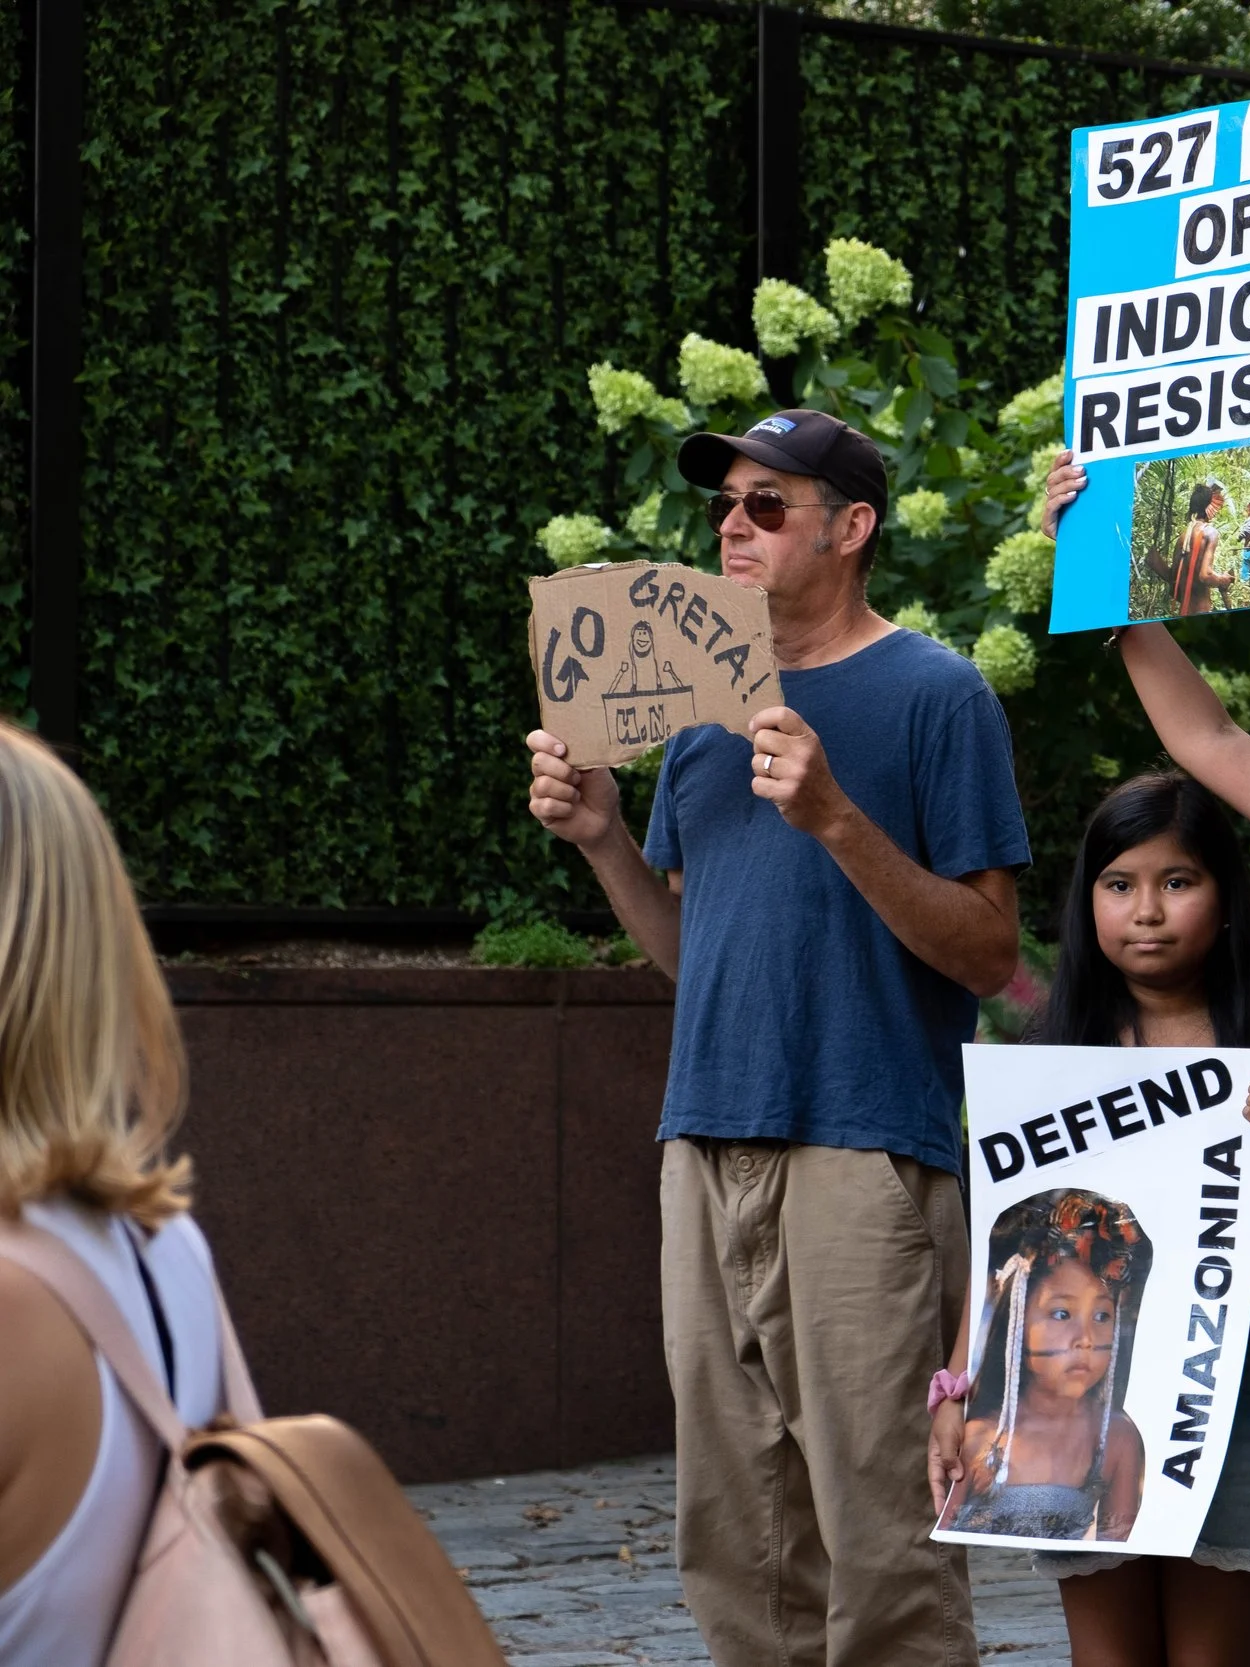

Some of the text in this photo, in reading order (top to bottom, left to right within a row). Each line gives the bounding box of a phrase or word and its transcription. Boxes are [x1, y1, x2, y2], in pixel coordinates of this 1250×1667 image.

[1096, 121, 1212, 200] 527
[542, 569, 772, 704] GO GRETA!
[978, 1057, 1234, 1184] DEFEND
[1161, 1134, 1243, 1490] AMAZONIA
